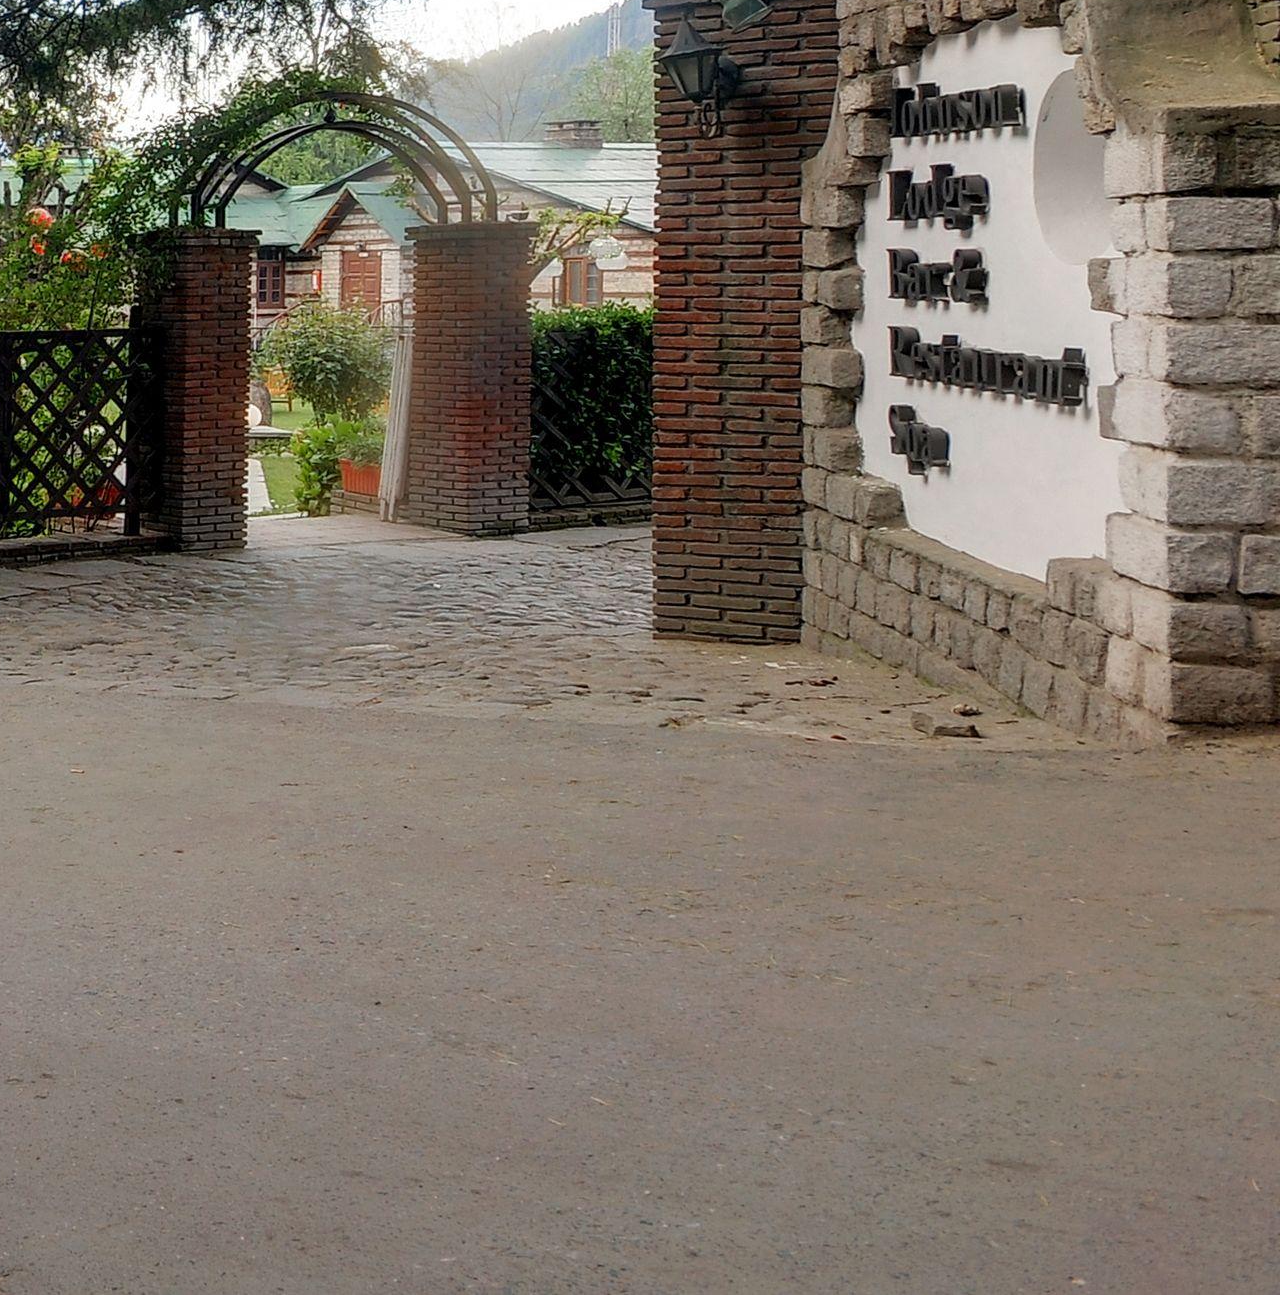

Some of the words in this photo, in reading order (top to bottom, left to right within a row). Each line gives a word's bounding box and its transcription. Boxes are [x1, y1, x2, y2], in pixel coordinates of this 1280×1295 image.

[886, 163, 991, 231] Lodge
[886, 248, 953, 302] Bar
[888, 326, 1090, 406] Restaurant
